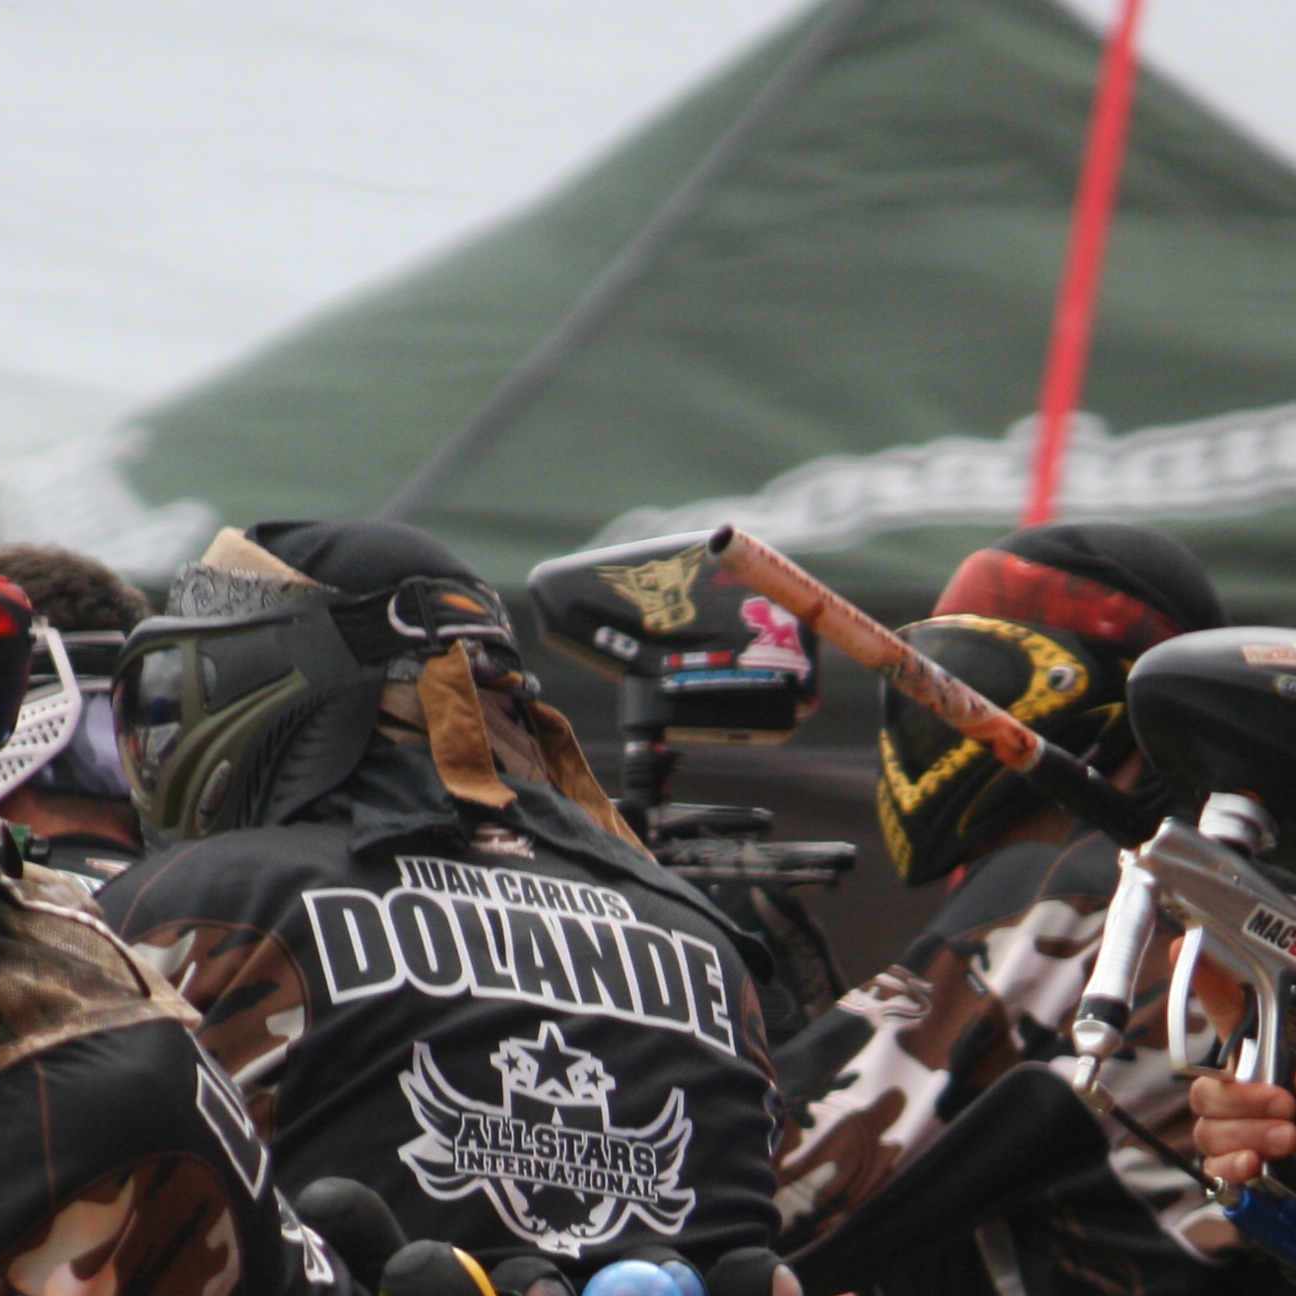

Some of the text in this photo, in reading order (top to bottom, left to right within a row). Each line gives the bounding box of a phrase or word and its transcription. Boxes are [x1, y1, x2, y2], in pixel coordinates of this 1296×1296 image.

[396, 856, 636, 923] JUAN CARLOS
[302, 887, 736, 1056] DOLANDE
[456, 1112, 657, 1179] ALLSTARS
[456, 1149, 659, 1203] INTERNATIONAL
